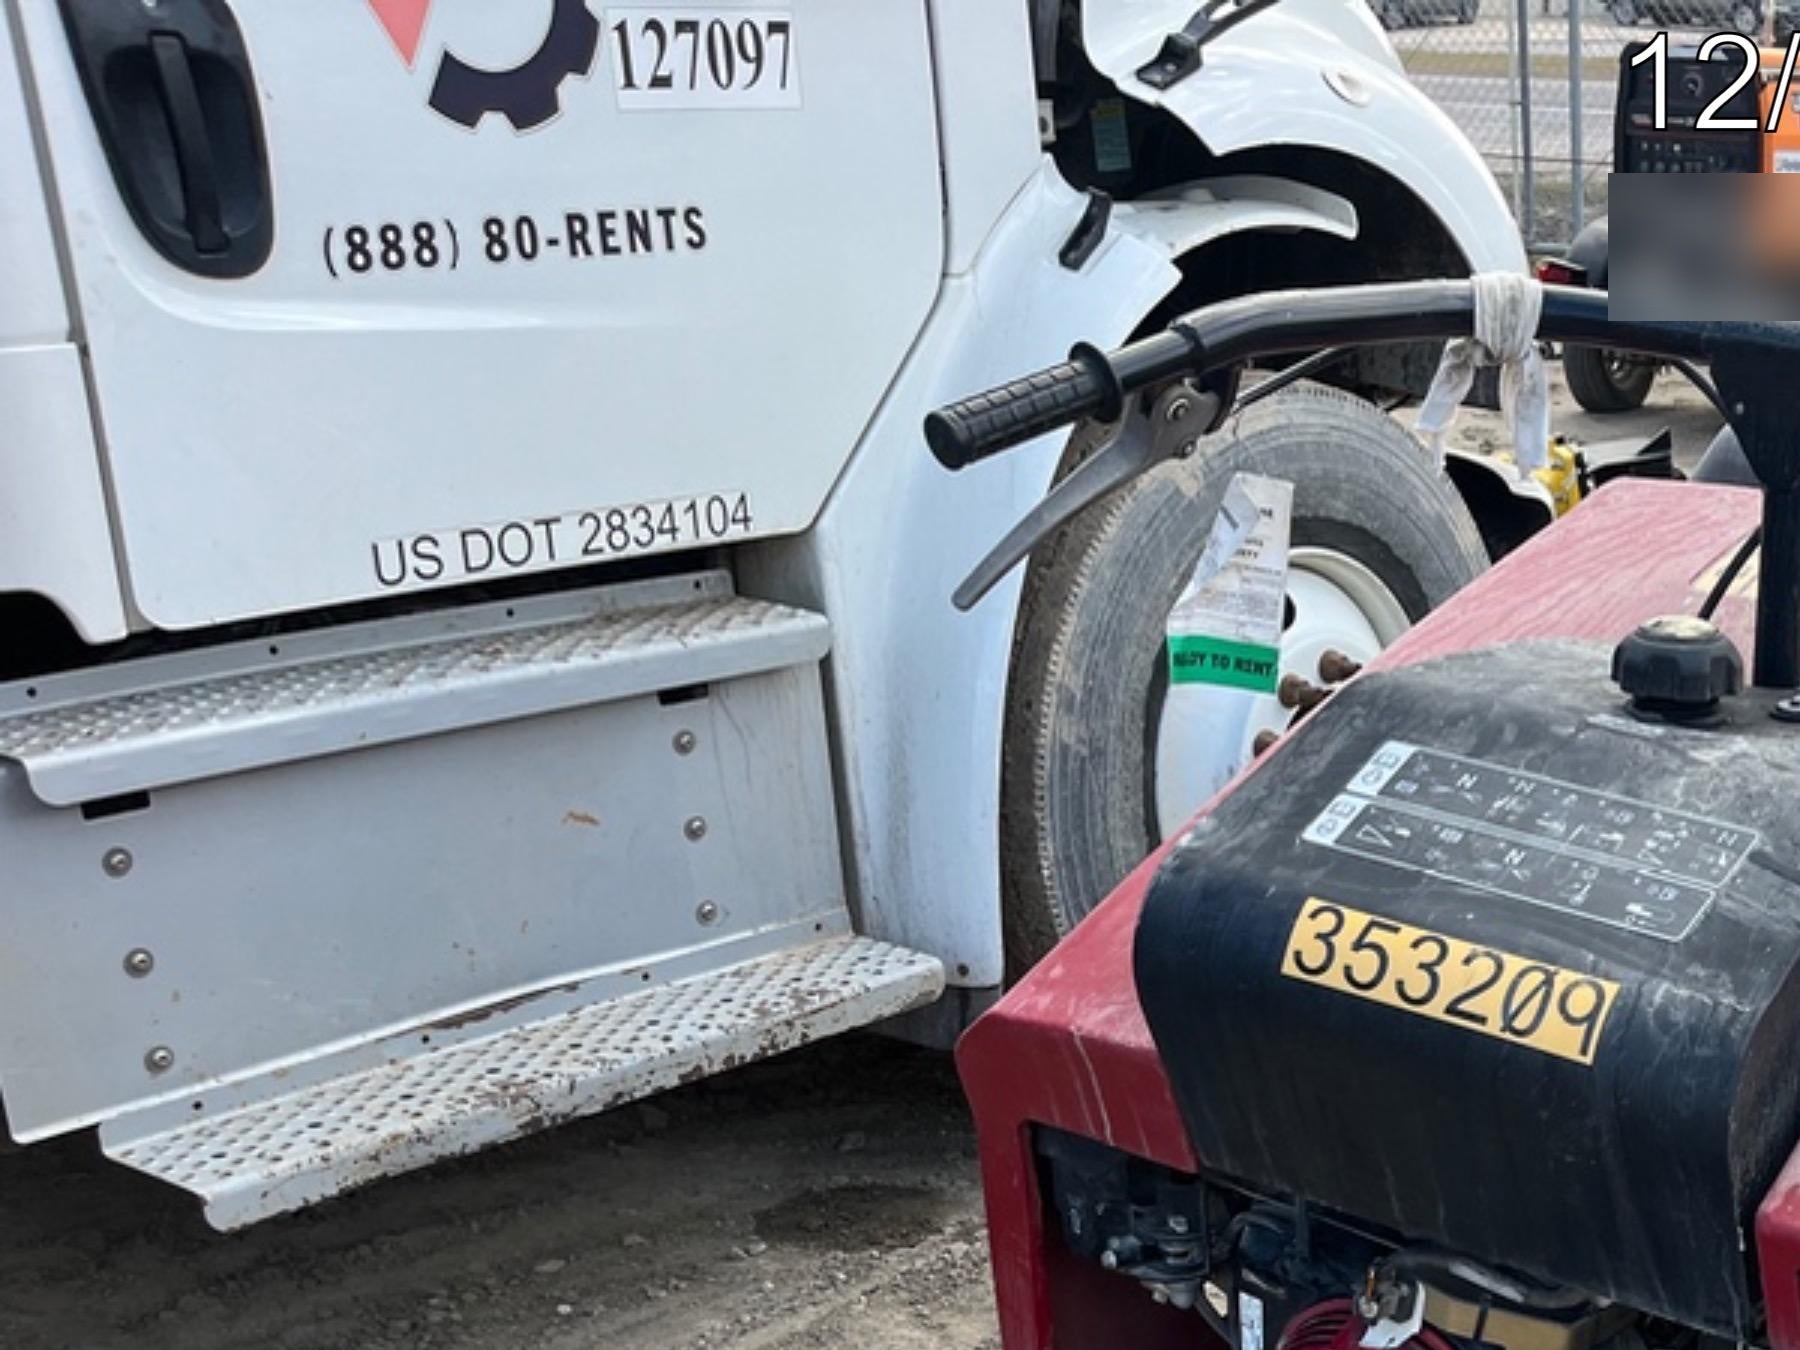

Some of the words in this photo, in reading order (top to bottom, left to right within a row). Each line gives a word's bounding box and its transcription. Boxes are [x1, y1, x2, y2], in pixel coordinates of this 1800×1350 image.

[612, 18, 791, 91] 127097
[322, 220, 460, 279] (888)
[483, 206, 708, 264] 80-RENTS
[371, 535, 446, 587] US
[460, 517, 563, 575] DOT
[577, 492, 753, 557] 2834104
[1293, 906, 1607, 1057] 353209
